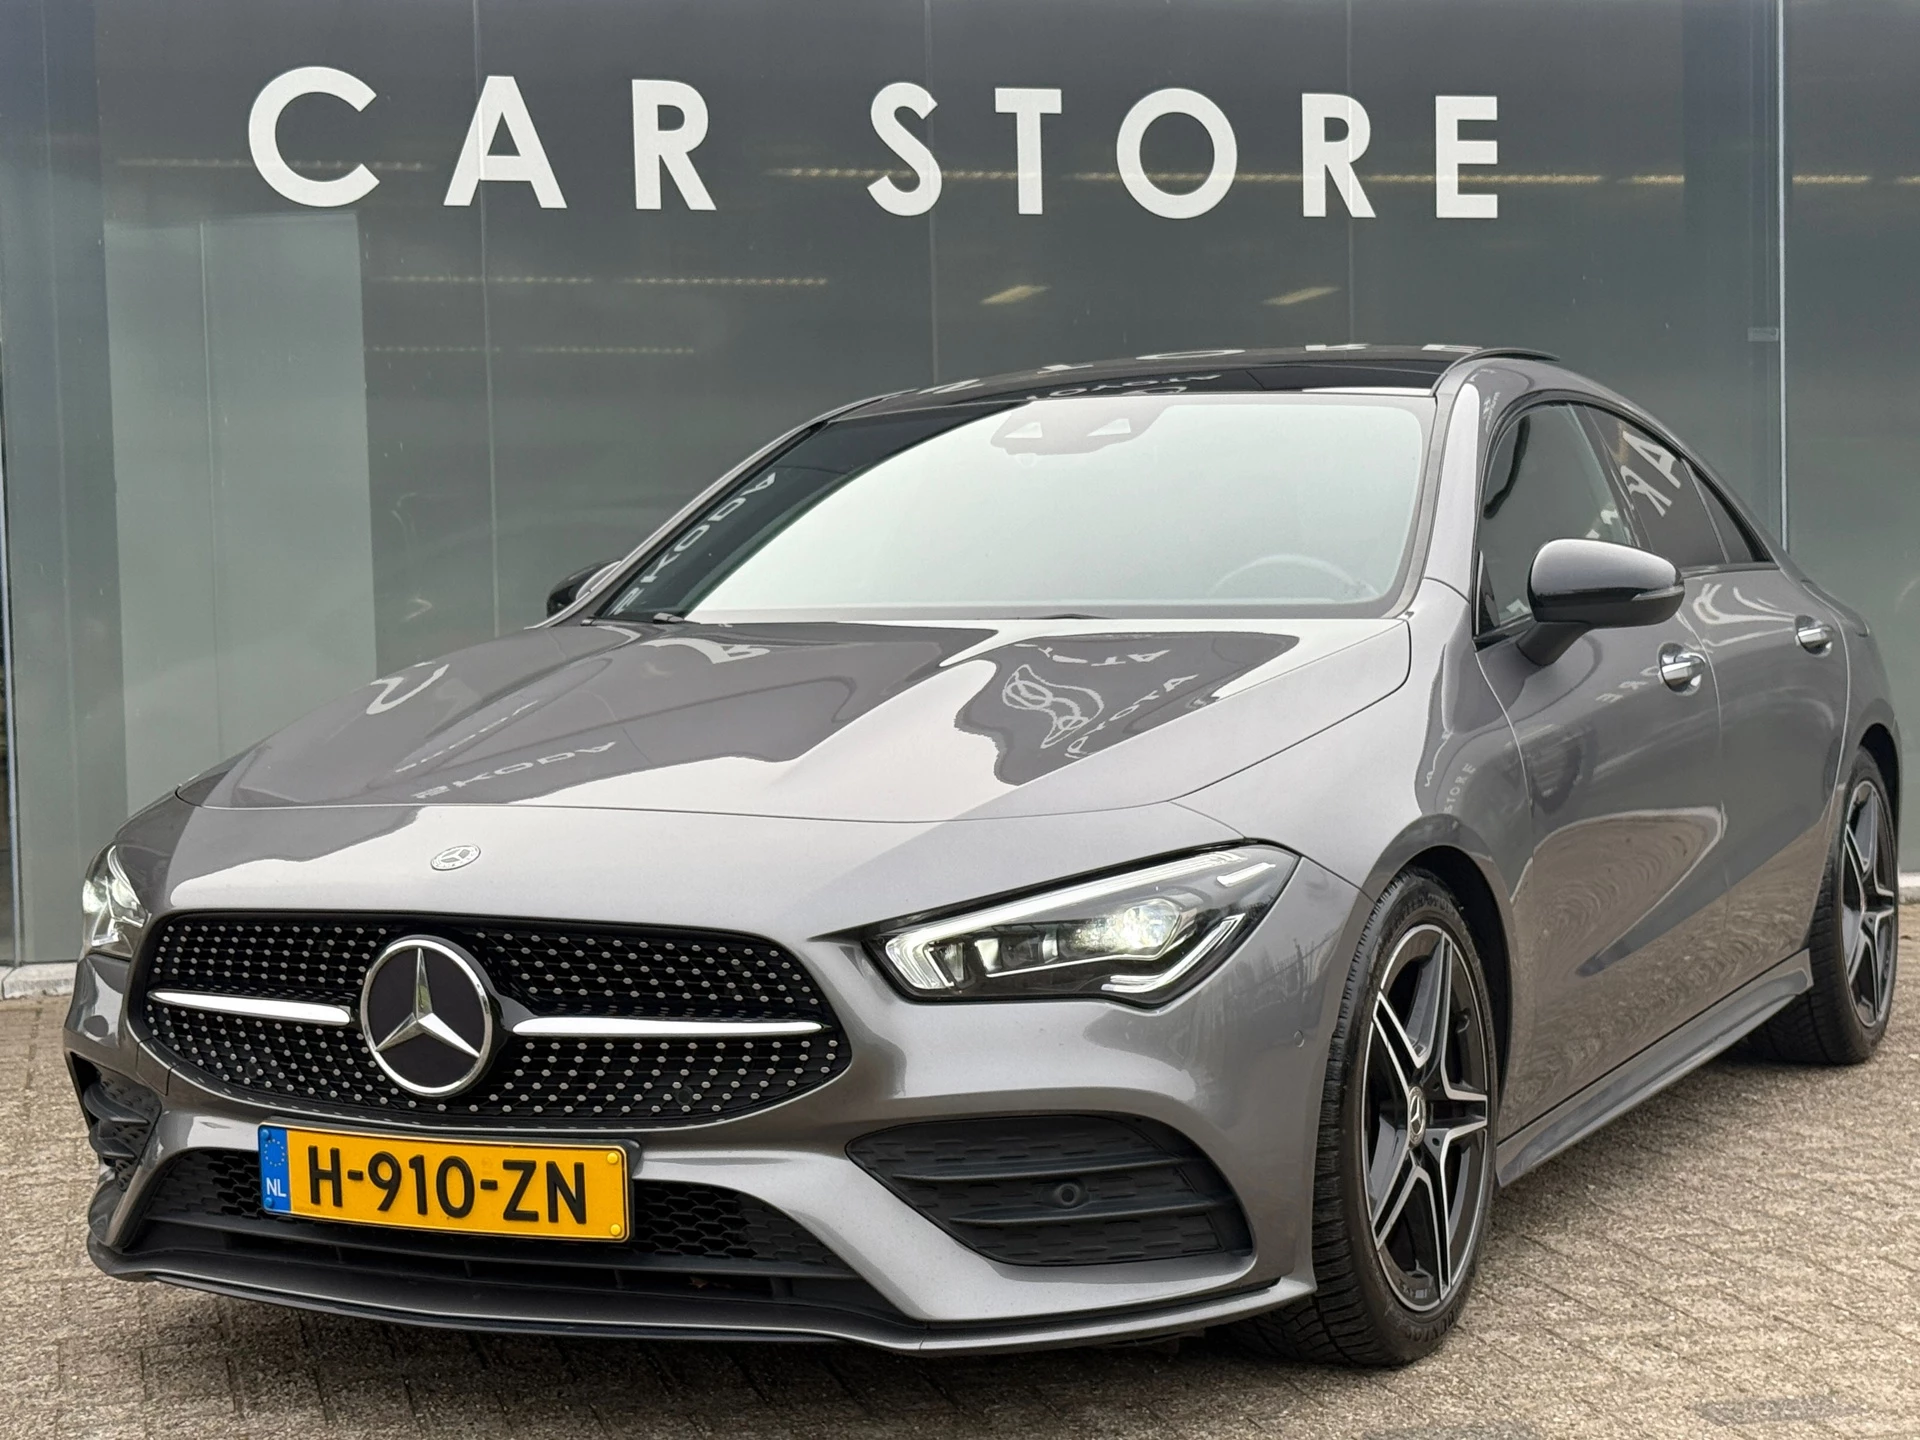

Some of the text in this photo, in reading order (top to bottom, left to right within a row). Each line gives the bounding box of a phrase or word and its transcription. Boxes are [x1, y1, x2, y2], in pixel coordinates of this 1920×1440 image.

[248, 66, 1498, 219] CAR STORE
[265, 1176, 287, 1198] NL
[308, 1145, 588, 1225] H-910-ZN
